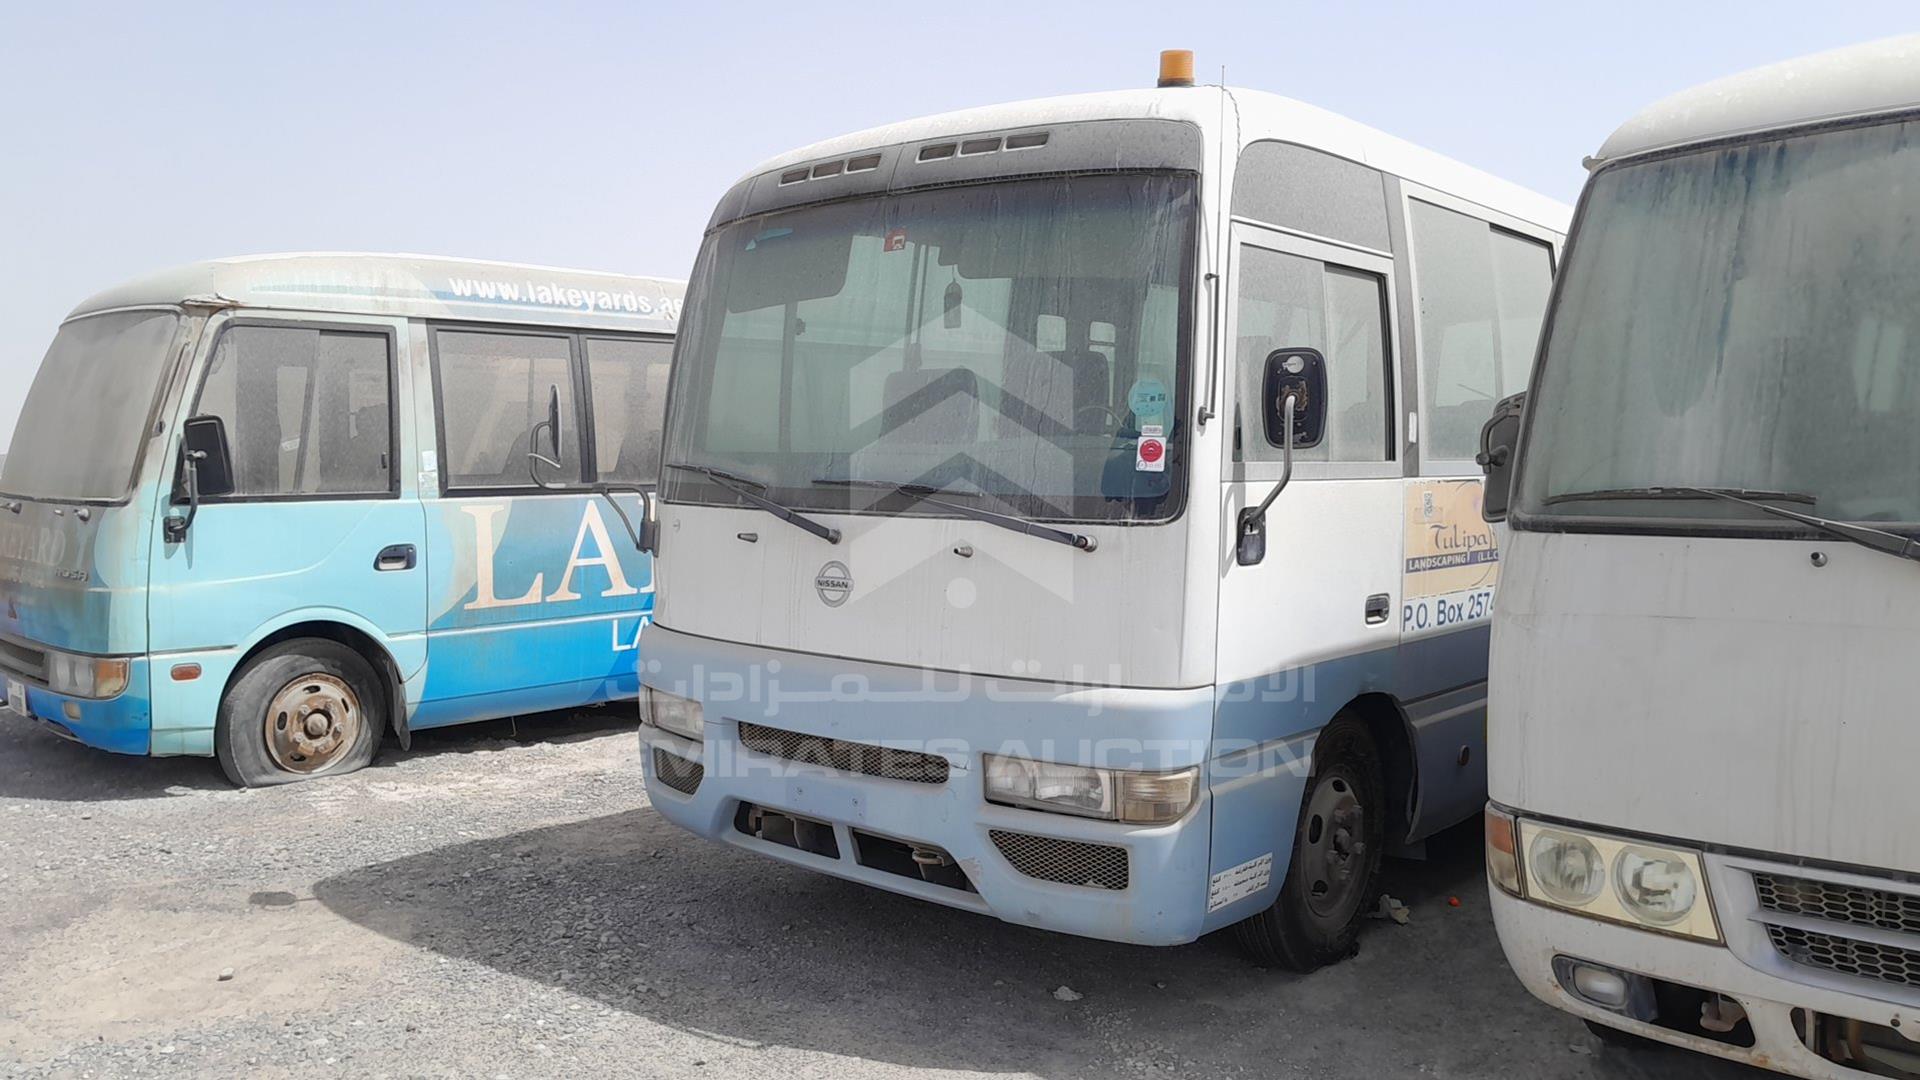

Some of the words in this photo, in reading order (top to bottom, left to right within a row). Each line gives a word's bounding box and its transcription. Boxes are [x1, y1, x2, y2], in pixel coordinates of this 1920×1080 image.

[449, 277, 684, 314] www.lakeyards.ae
[461, 499, 655, 610] LA
[1408, 551, 1467, 571] LANDSCAPING
[817, 579, 849, 589] NISSAN
[1403, 603, 1431, 632] P.O.
[1437, 599, 1463, 625] Box
[1468, 592, 1493, 620] 257
